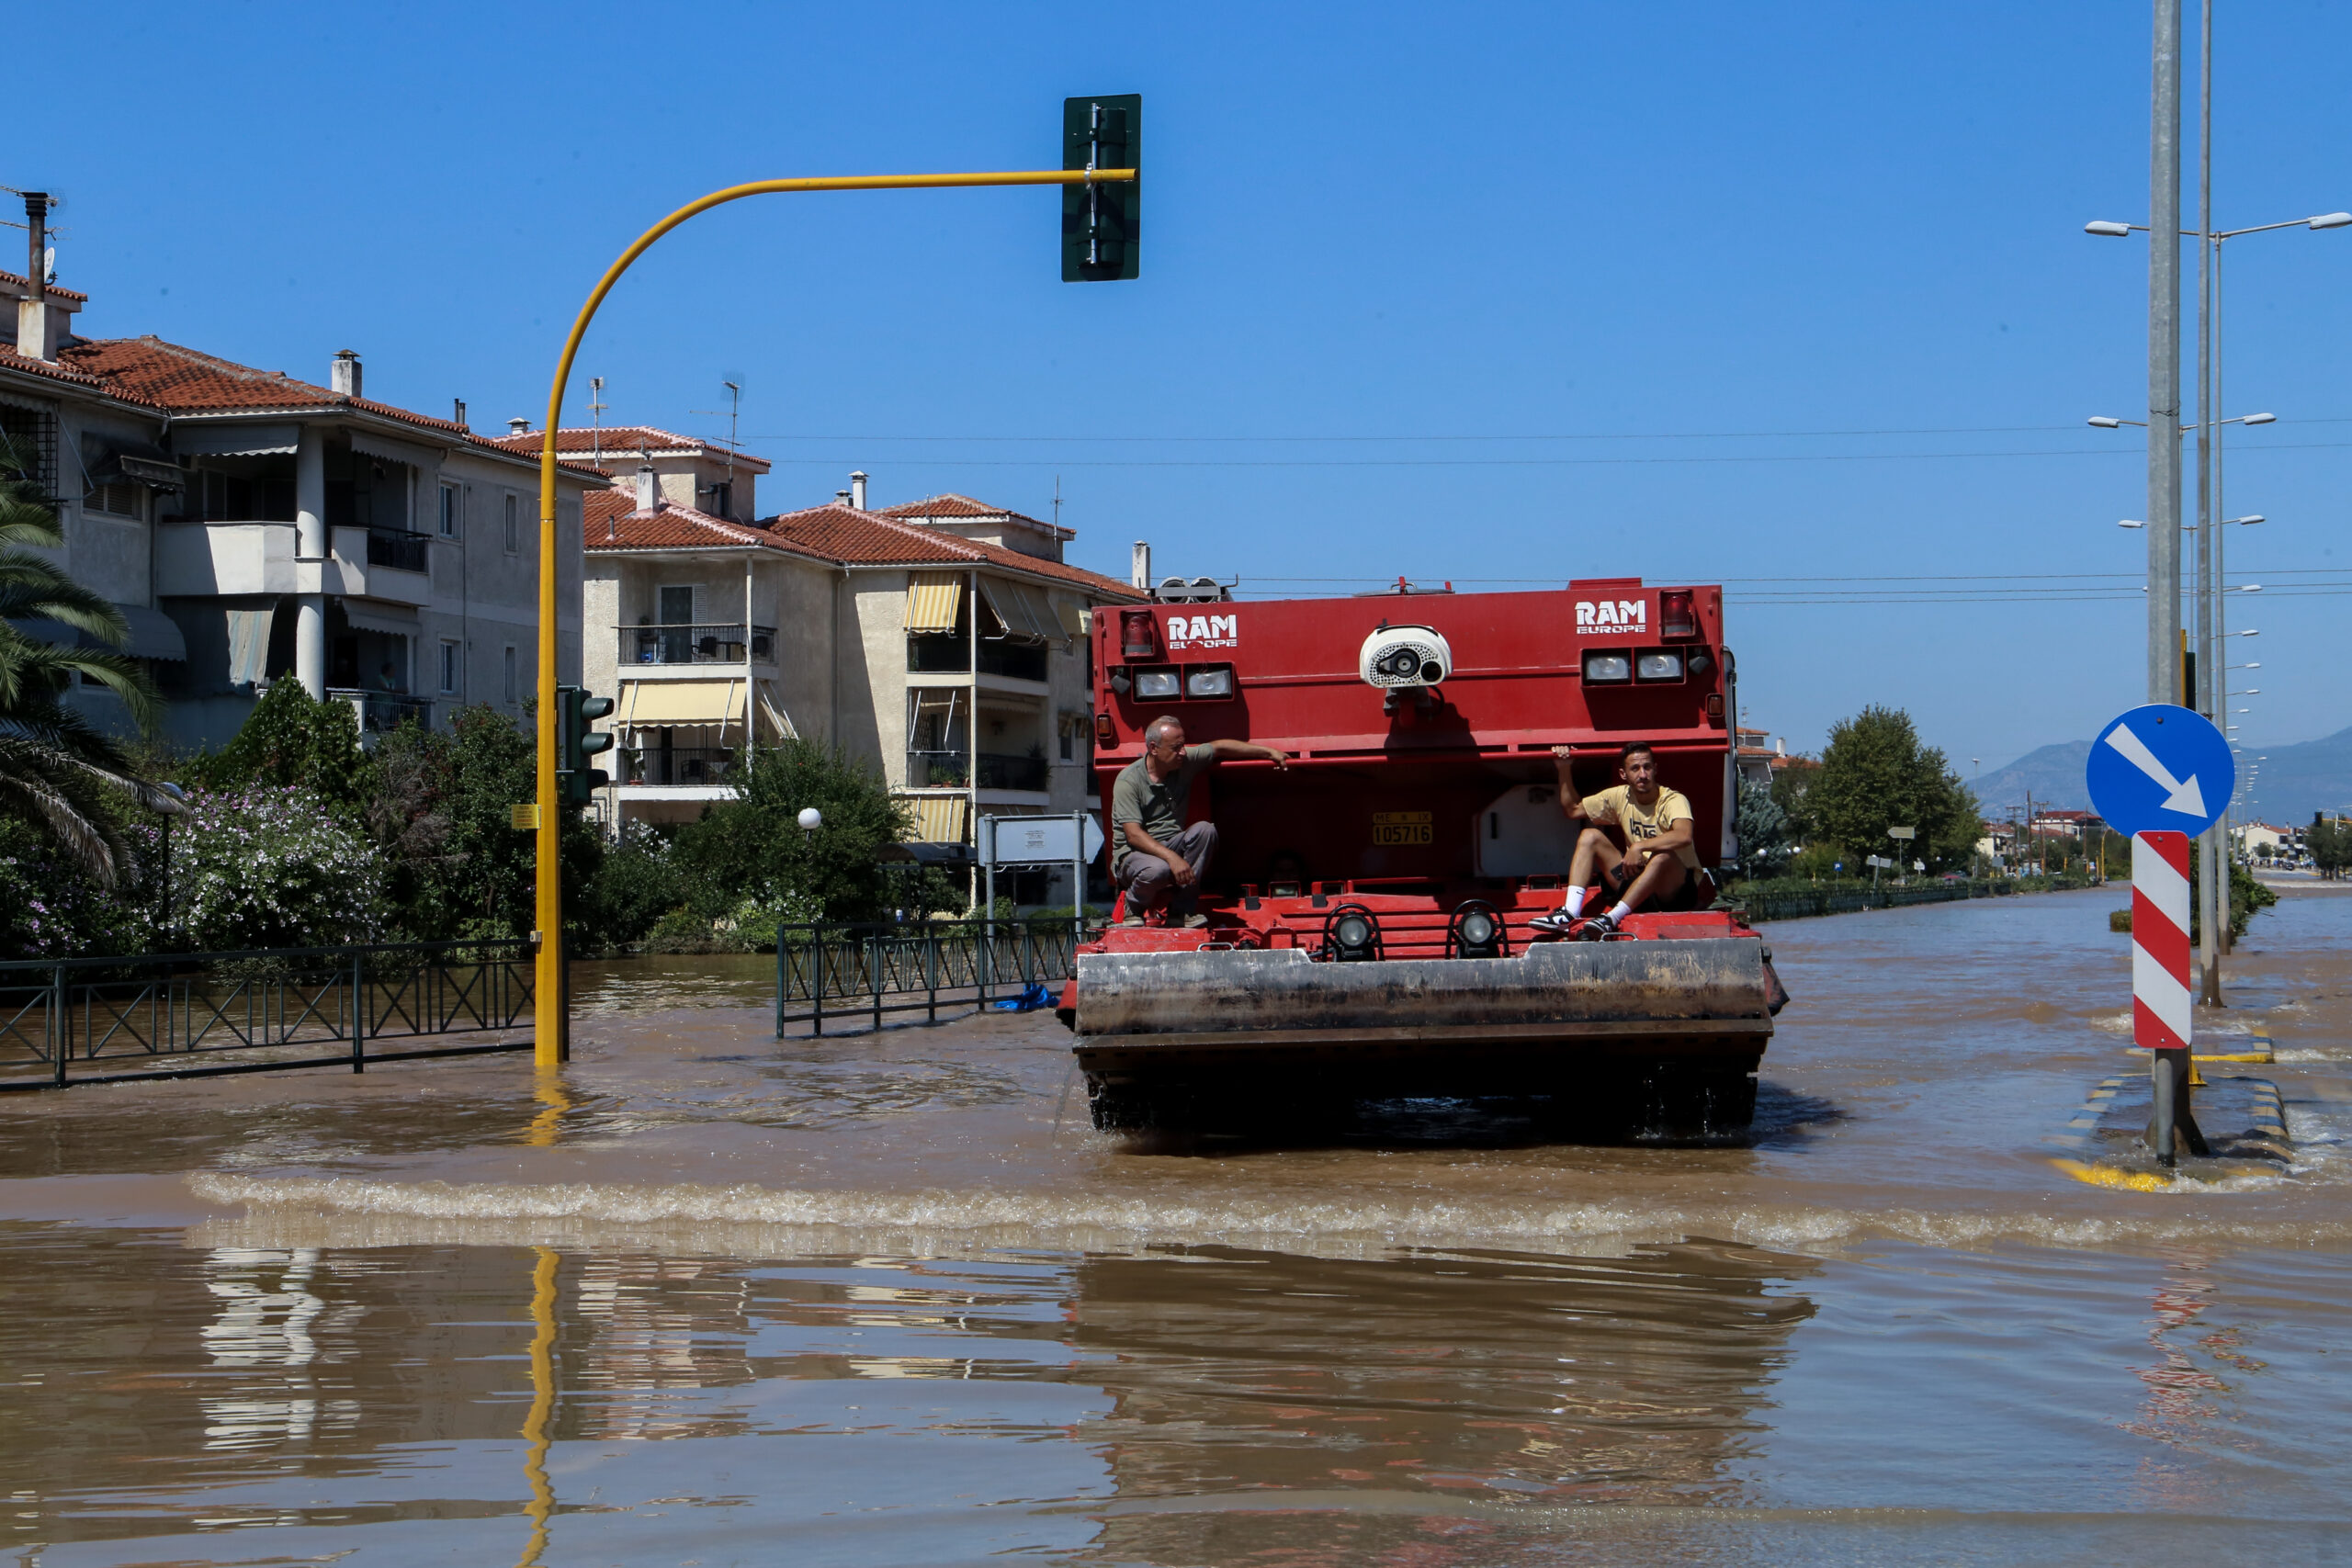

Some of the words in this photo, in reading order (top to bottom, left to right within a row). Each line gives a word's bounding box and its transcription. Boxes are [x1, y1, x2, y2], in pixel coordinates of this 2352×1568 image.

[1575, 600, 1645, 625] RAM
[1167, 615, 1237, 640] RAM
[1576, 625, 1645, 634] EUROPE
[1169, 639, 1237, 649] EUOPE
[1375, 825, 1430, 842] 105716
